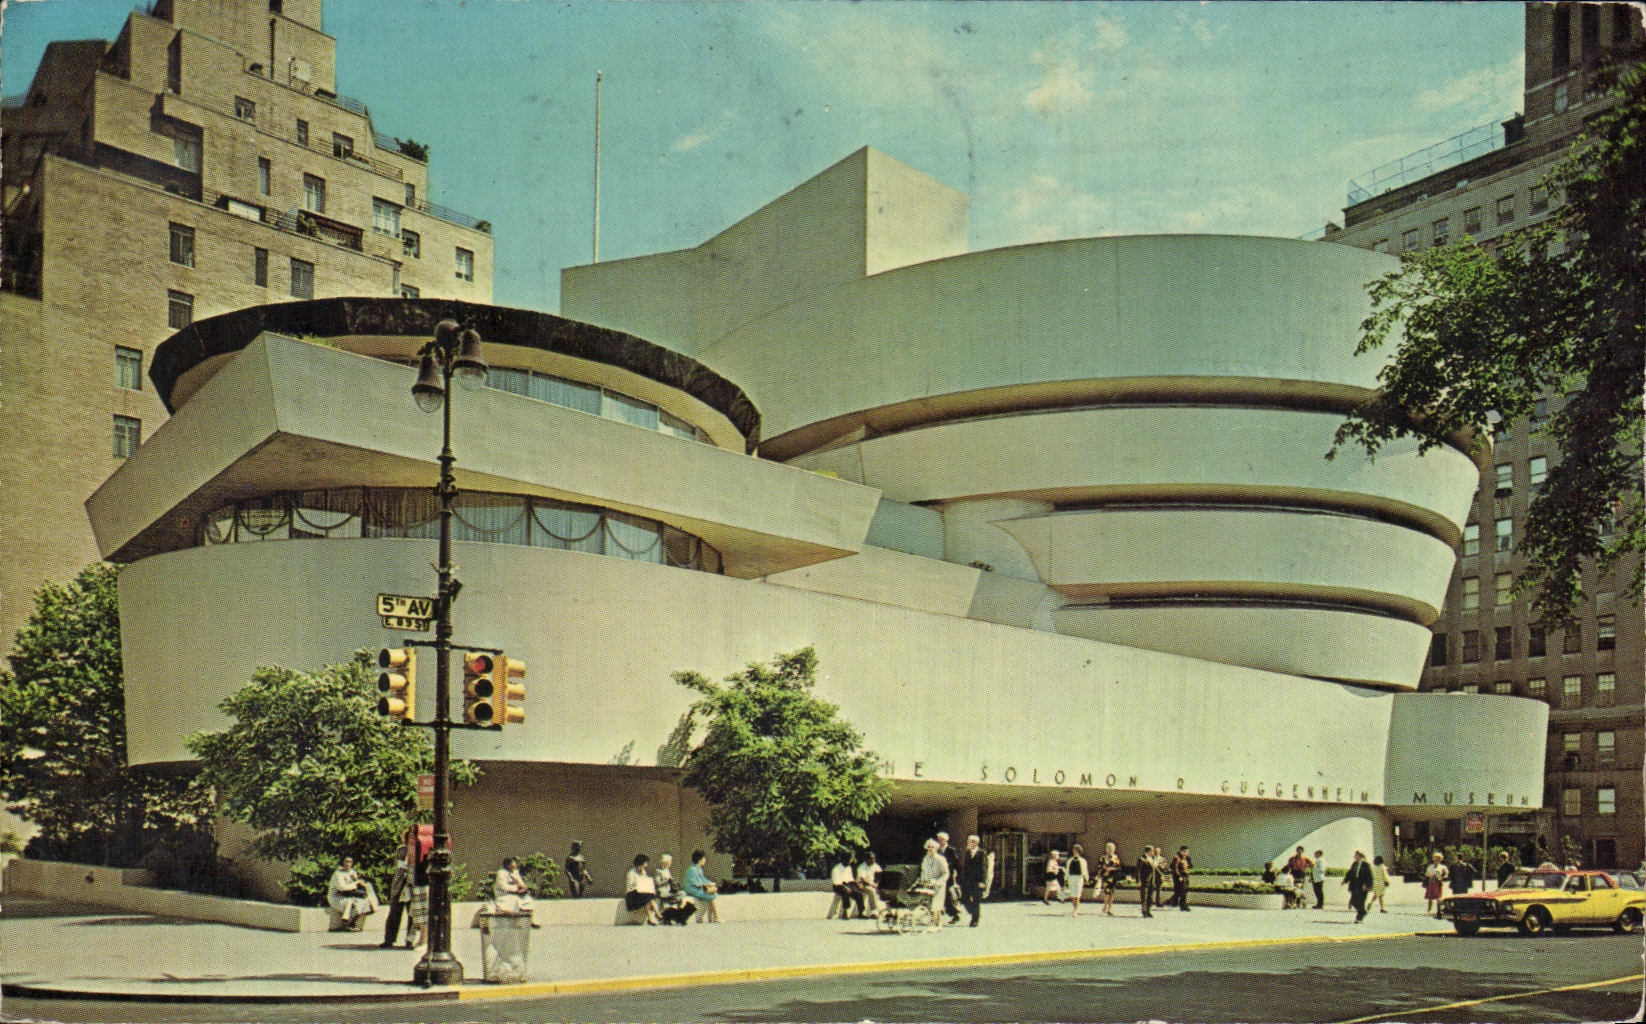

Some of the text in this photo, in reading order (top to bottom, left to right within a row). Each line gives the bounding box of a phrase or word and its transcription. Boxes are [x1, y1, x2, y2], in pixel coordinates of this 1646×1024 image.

[382, 596, 431, 616] 5TH AV
[980, 764, 1138, 789] SOLOMON
[1220, 779, 1370, 803] GUGGENHEIM
[1412, 791, 1530, 806] MUSEUM
